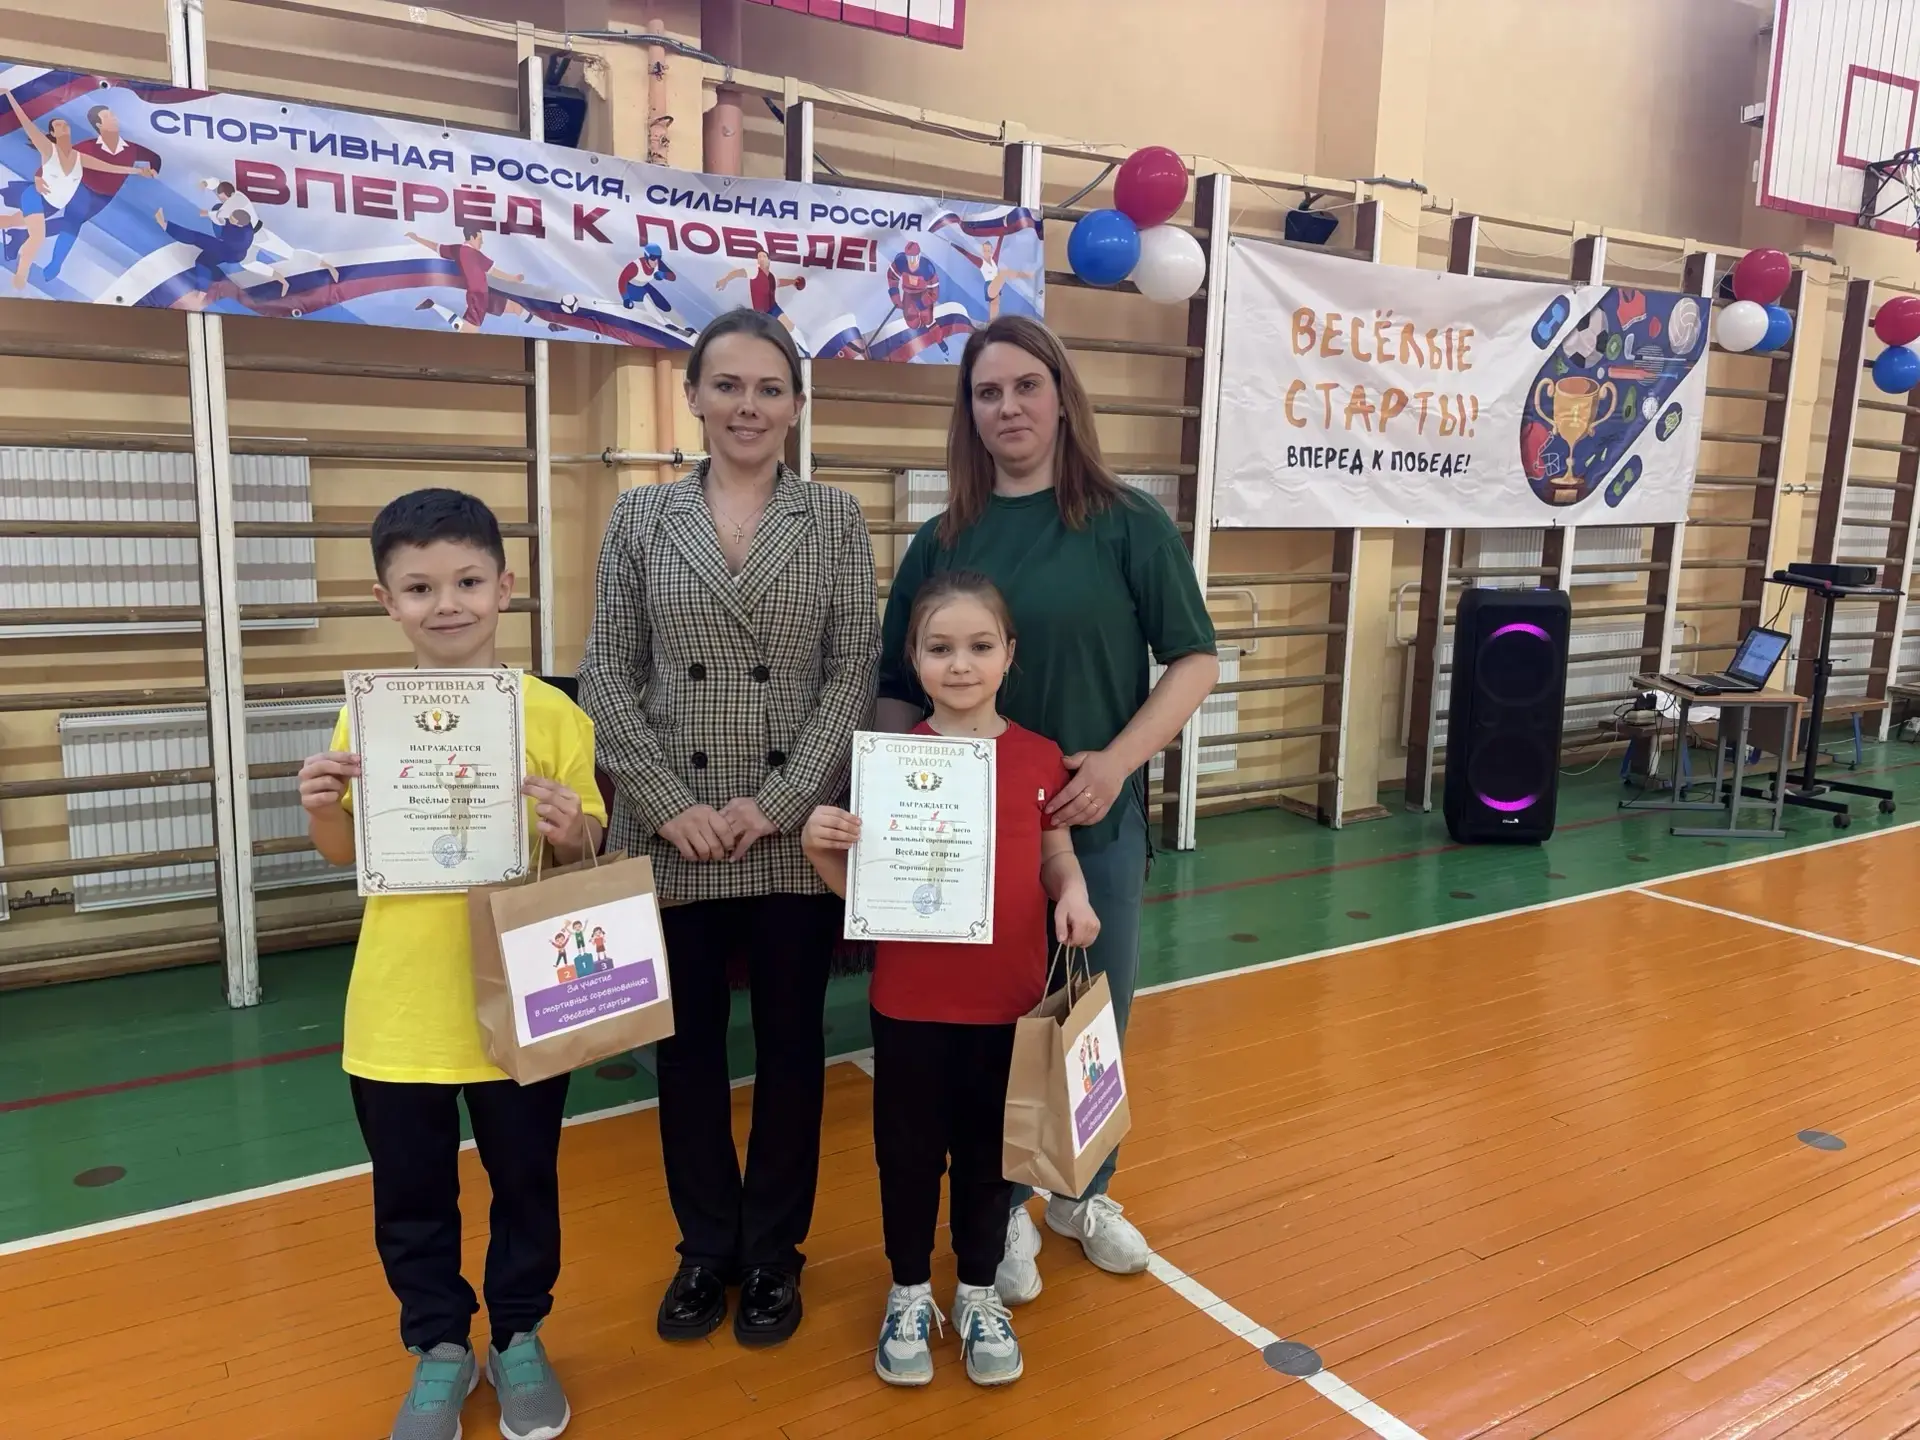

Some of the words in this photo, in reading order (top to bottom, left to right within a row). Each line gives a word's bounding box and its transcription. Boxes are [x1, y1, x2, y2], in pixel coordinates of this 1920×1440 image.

[150, 109, 454, 173] СПОРТИВНАЯ
[470, 154, 631, 202] РОССИЯ,
[646, 184, 799, 220] СИЛЬНАЯ
[810, 207, 922, 232] РОССИЯ
[234, 158, 546, 239] ВПЕРЁД
[573, 204, 615, 244] К
[635, 213, 878, 272] ПОБЕДЕ!
[1291, 306, 1475, 372] ВЕСЁЛЫЕ
[1284, 378, 1479, 438] СТАРТЫ!
[1287, 445, 1364, 475] ВПЕРЕД
[1372, 449, 1383, 472] К
[1391, 450, 1471, 478] ПОБЕДЕ!
[386, 681, 485, 692] СПОРТИВНАЯ
[402, 695, 470, 705] ГРАМОТА
[410, 744, 481, 752] НАГРАЖДАЕТСЯ
[885, 743, 965, 756] СПОРТИВНАЯ
[897, 756, 952, 768] ГРАМОТА
[409, 796, 450, 805] Весёлые
[451, 797, 486, 806] старты
[899, 801, 959, 810] НАГРАЖДАЕТСЯ
[895, 848, 929, 857] Весёлые
[930, 851, 960, 859] старты
[566, 984, 579, 994] За
[580, 974, 612, 990] участие
